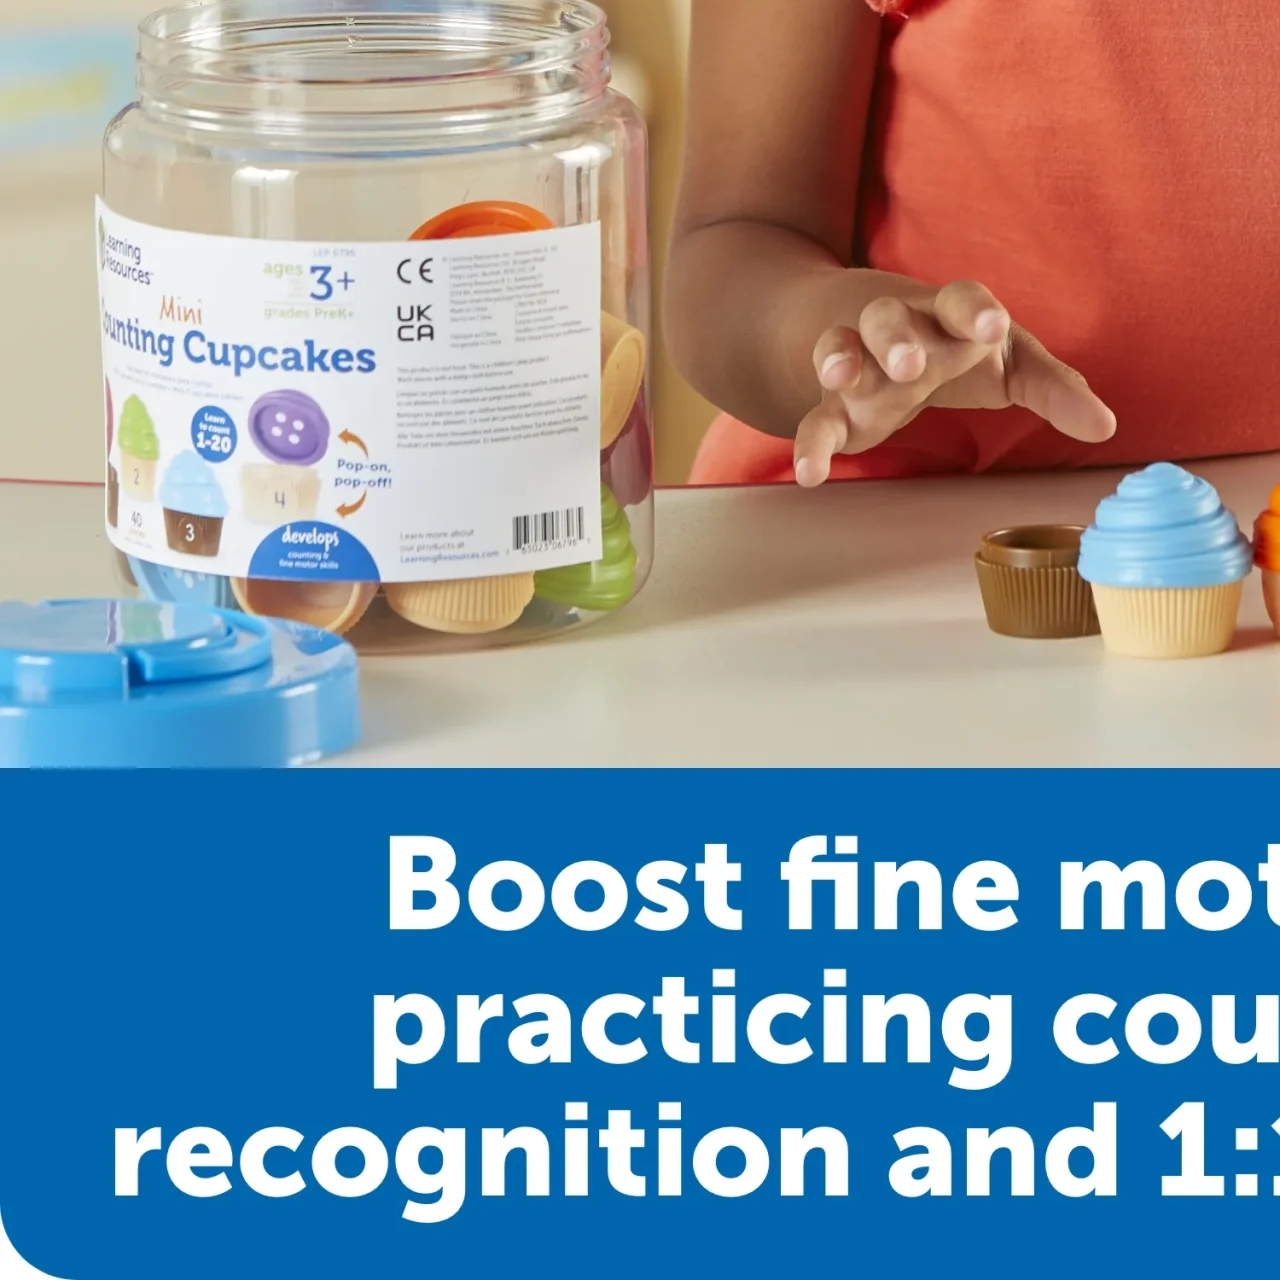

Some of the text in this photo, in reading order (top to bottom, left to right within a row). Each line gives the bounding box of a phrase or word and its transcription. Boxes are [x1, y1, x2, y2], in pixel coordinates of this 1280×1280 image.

[263, 262, 304, 279] ages
[310, 265, 355, 301] 3+
[159, 295, 203, 325] Mini
[263, 306, 310, 320] grades
[397, 304, 433, 322] UK
[102, 297, 175, 368] ounting
[183, 329, 377, 377] Cupcakes
[204, 412, 226, 424] Learn
[199, 422, 231, 436] to count
[196, 431, 232, 454] 1-20
[337, 459, 392, 473] Pop-on,
[133, 468, 140, 486] 2
[334, 477, 393, 489] pop-off!
[274, 491, 286, 508] 4
[131, 510, 143, 528] 40
[185, 523, 195, 542] 3
[281, 524, 340, 553] develops
[288, 551, 322, 562] counting
